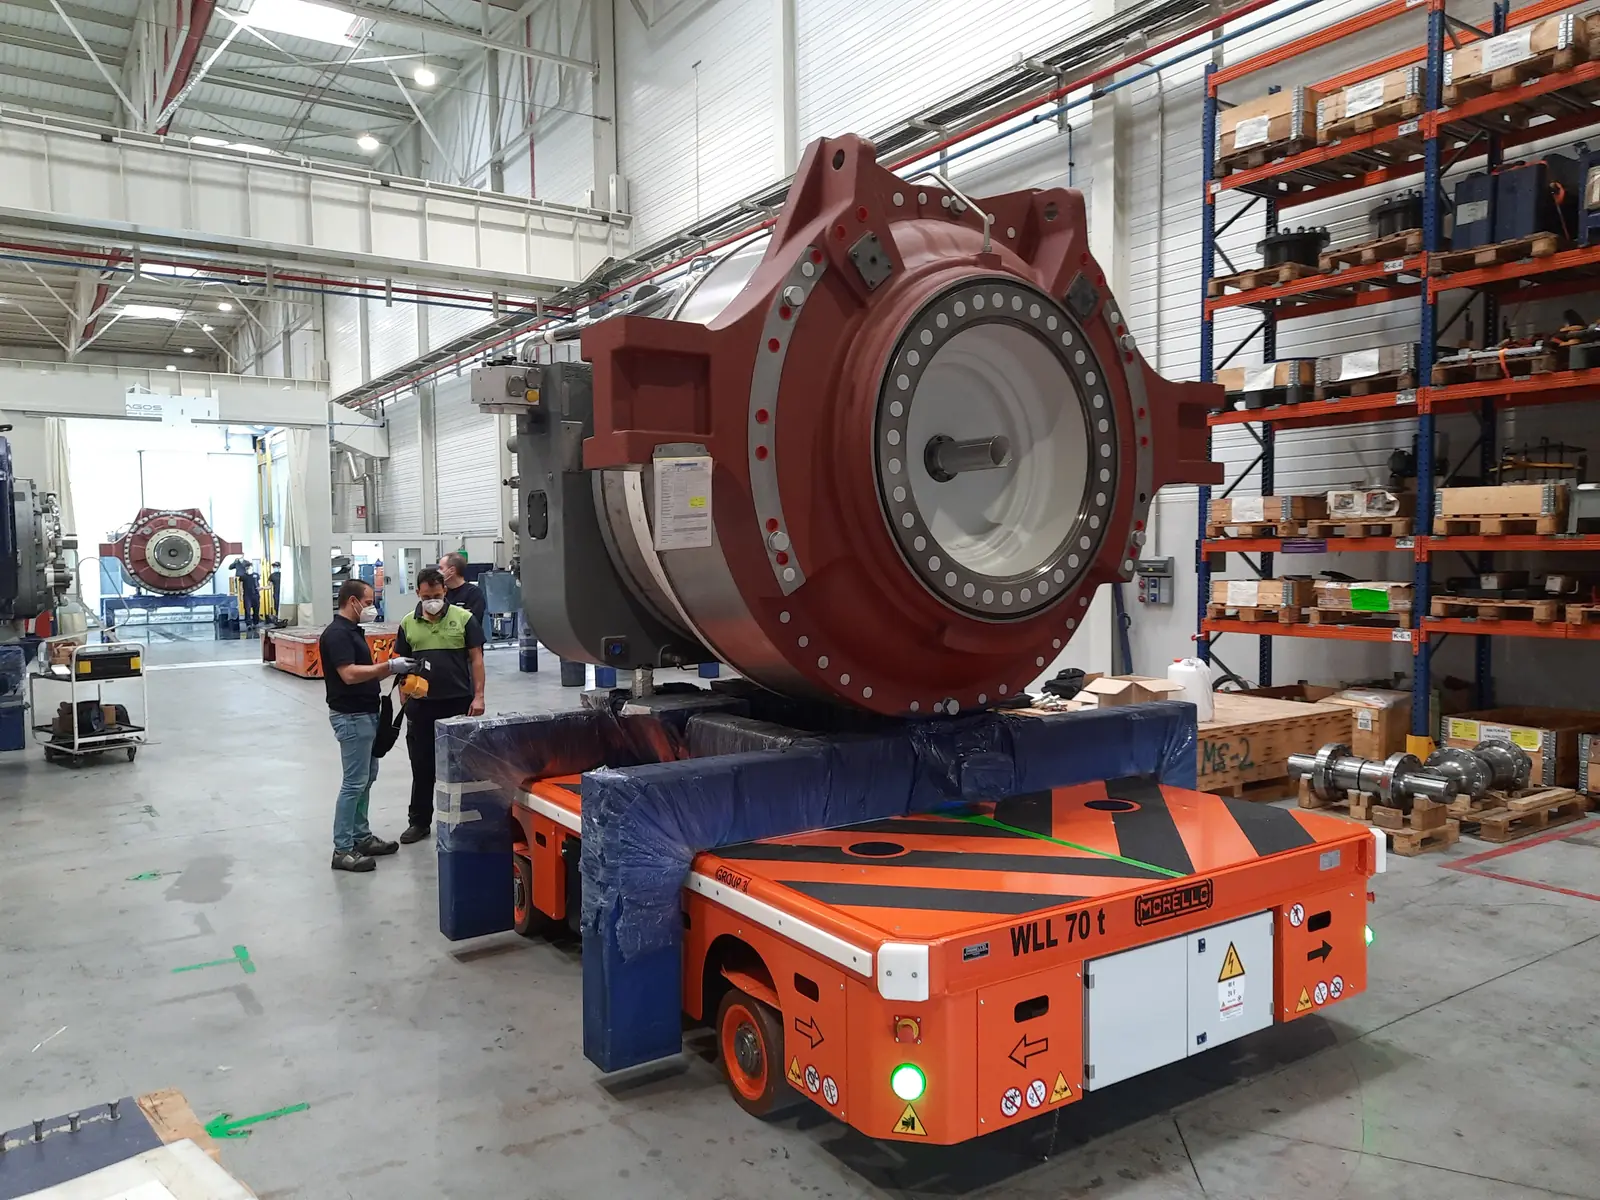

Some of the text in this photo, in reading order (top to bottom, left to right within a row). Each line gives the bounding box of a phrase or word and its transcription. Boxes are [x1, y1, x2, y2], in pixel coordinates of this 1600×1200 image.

[716, 869, 742, 888] GROUP
[1139, 885, 1209, 919] MORELLO
[1010, 918, 1058, 957] WLL
[1065, 910, 1091, 943] 70
[1097, 908, 1105, 935] t
